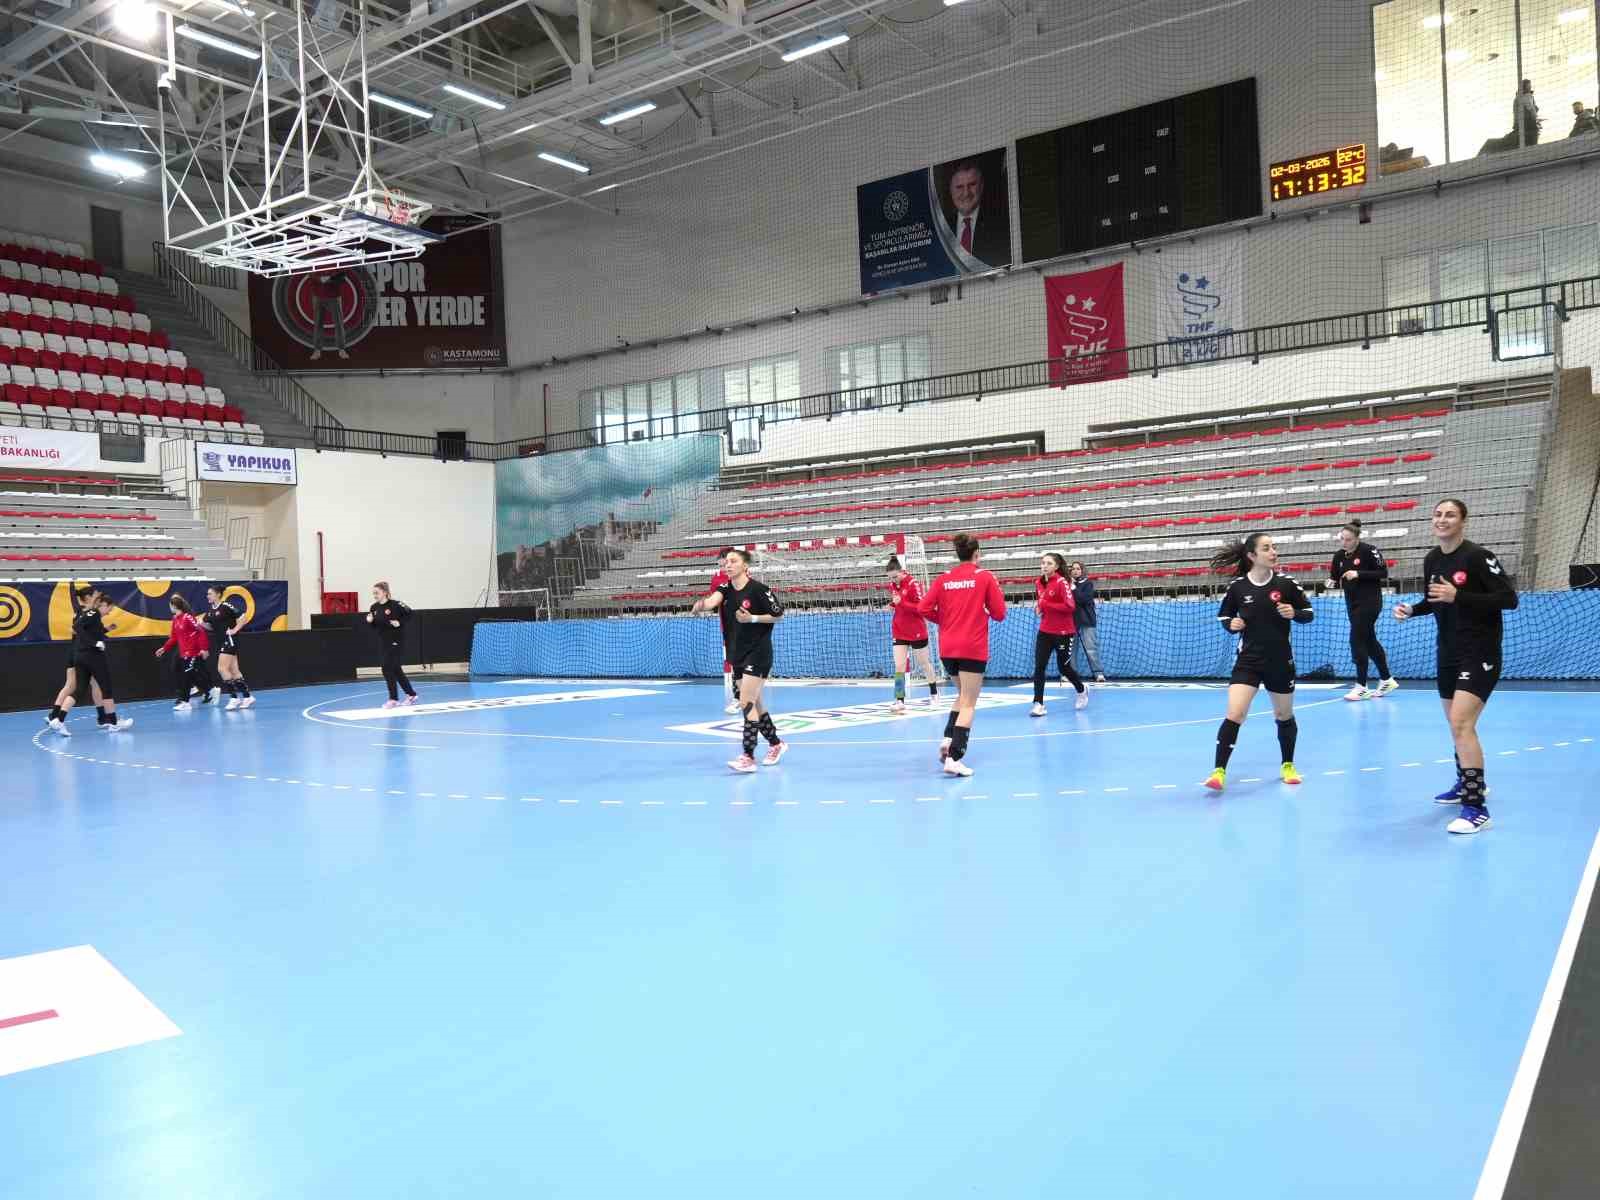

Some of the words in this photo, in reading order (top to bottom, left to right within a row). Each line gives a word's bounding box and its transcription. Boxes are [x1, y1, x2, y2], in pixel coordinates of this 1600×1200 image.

[1273, 165, 1365, 199] 17:13:32
[412, 296, 485, 327] YERDE
[1187, 321, 1214, 334] THF
[443, 349, 500, 358] KASTAMONU
[1062, 338, 1109, 364] THF
[0, 434, 18, 445] ETİ
[0, 446, 60, 459] BAKANLIĞI
[944, 580, 976, 590] TÜRKİYE
